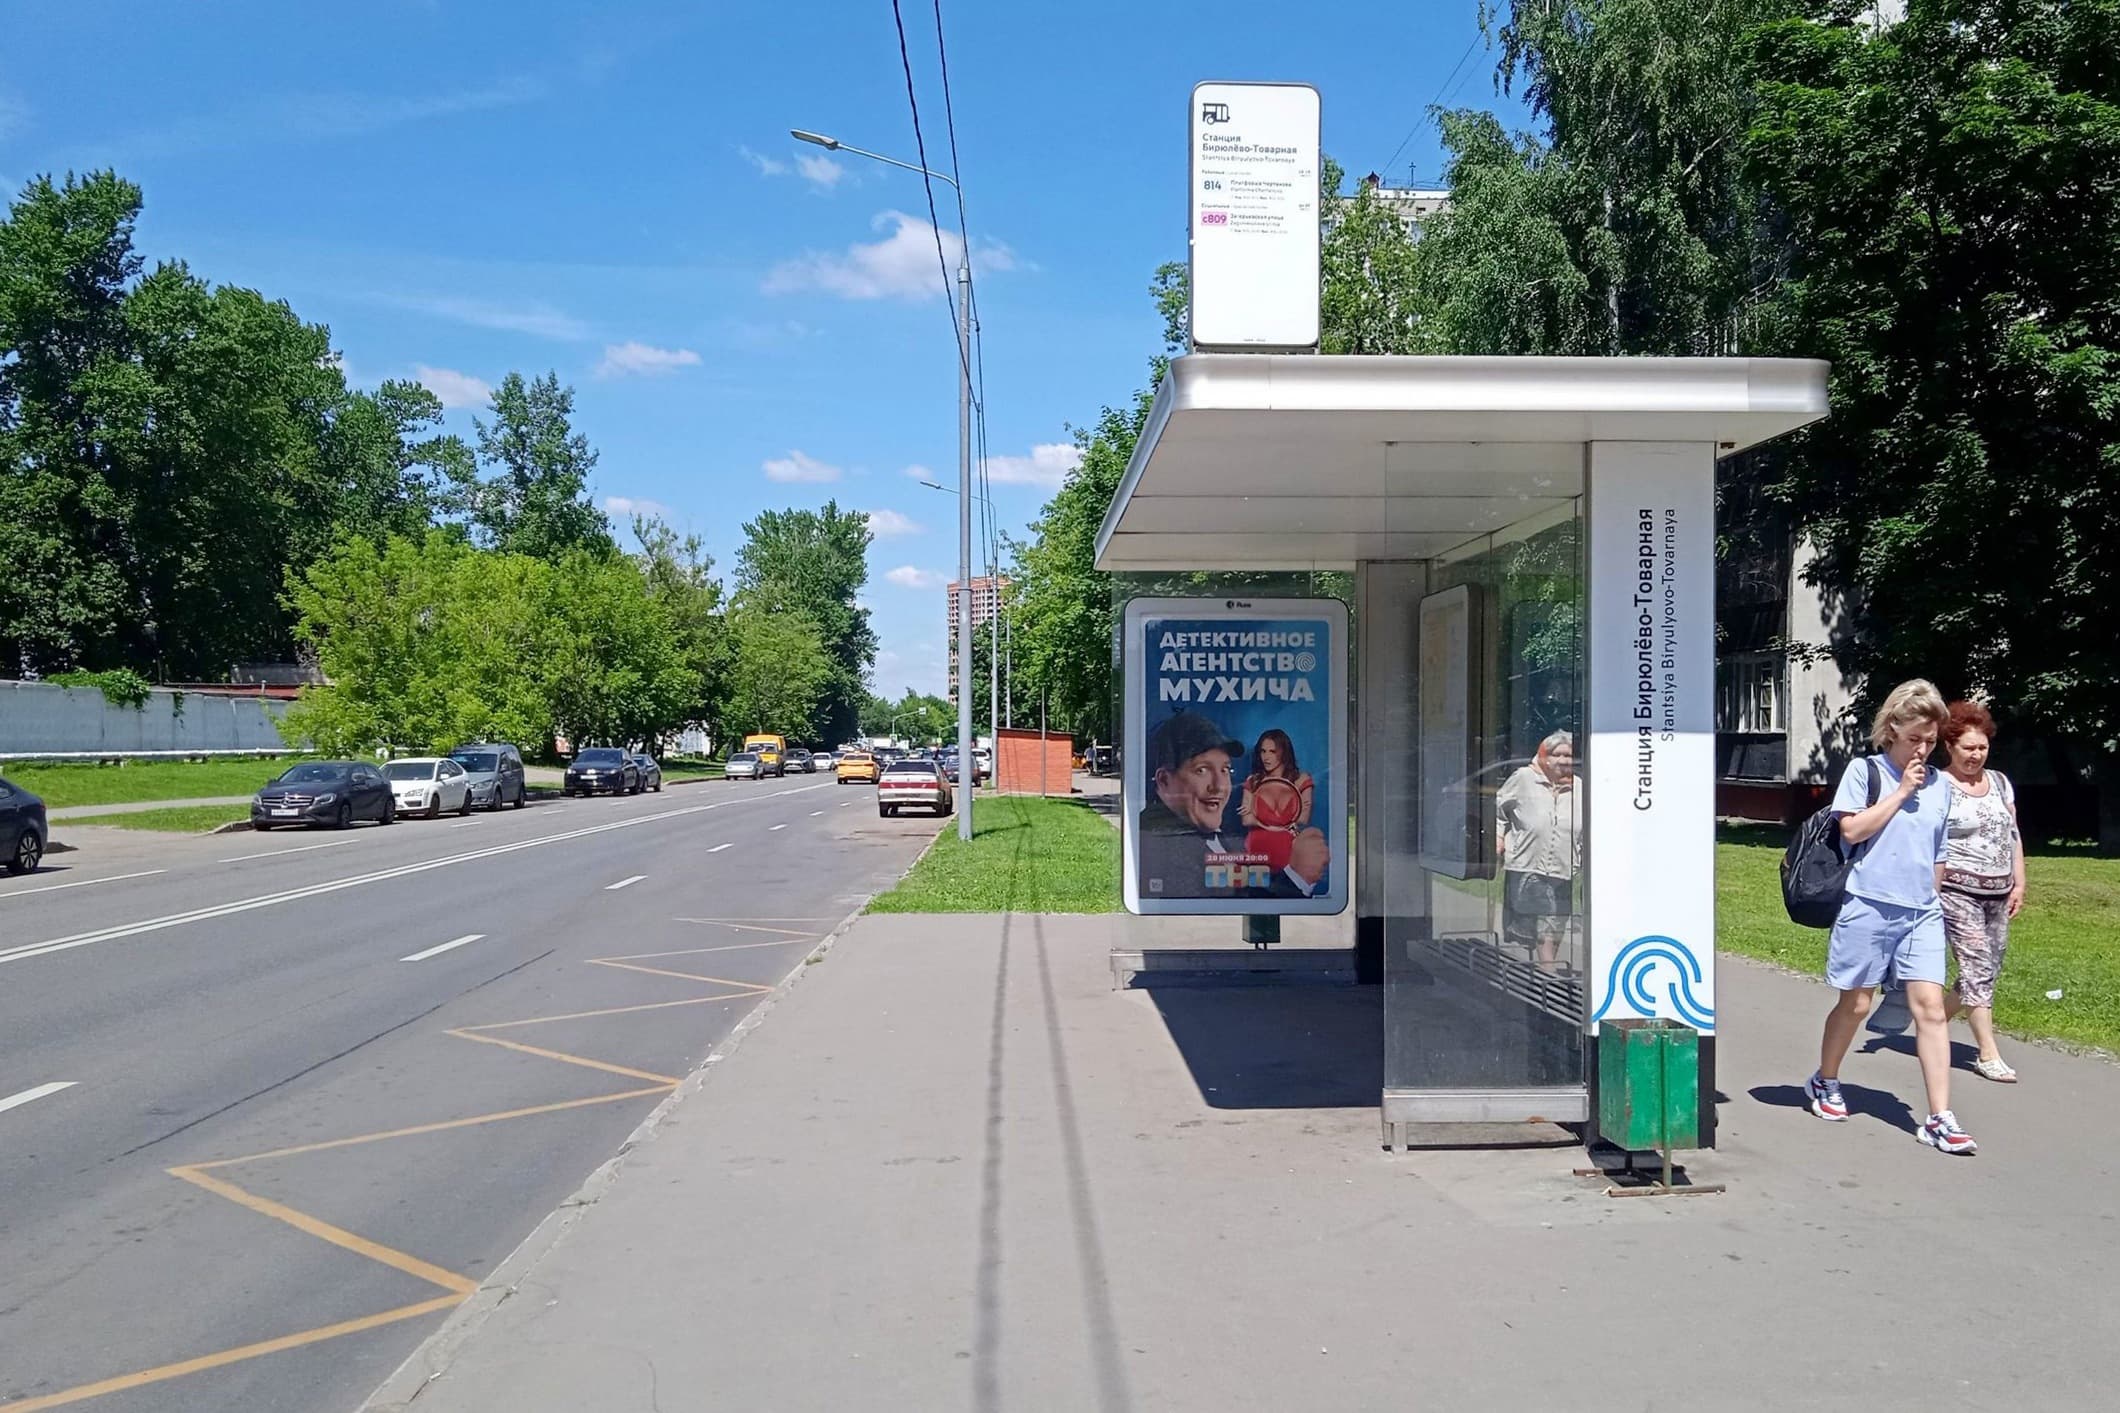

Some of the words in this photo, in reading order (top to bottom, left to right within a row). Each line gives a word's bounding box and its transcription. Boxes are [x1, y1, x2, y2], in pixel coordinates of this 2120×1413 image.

[1202, 133, 1242, 143] Станция
[1202, 143, 1298, 154] Бирюлёво-Товарная
[1203, 180, 1222, 190] 814
[1661, 509, 1678, 668] Biryulyovo-Tovarnaya
[1634, 509, 1657, 719] Бирюлёво-Товарная
[1160, 632, 1315, 649] ДЕТЕКТИВНОЕ
[1160, 652, 1316, 672] АГЕНТСТВО
[1160, 676, 1315, 702] МУХИЧА
[1661, 673, 1678, 741] Stantsiya
[1634, 726, 1655, 811] Станция
[1205, 863, 1270, 888] ТНТ
